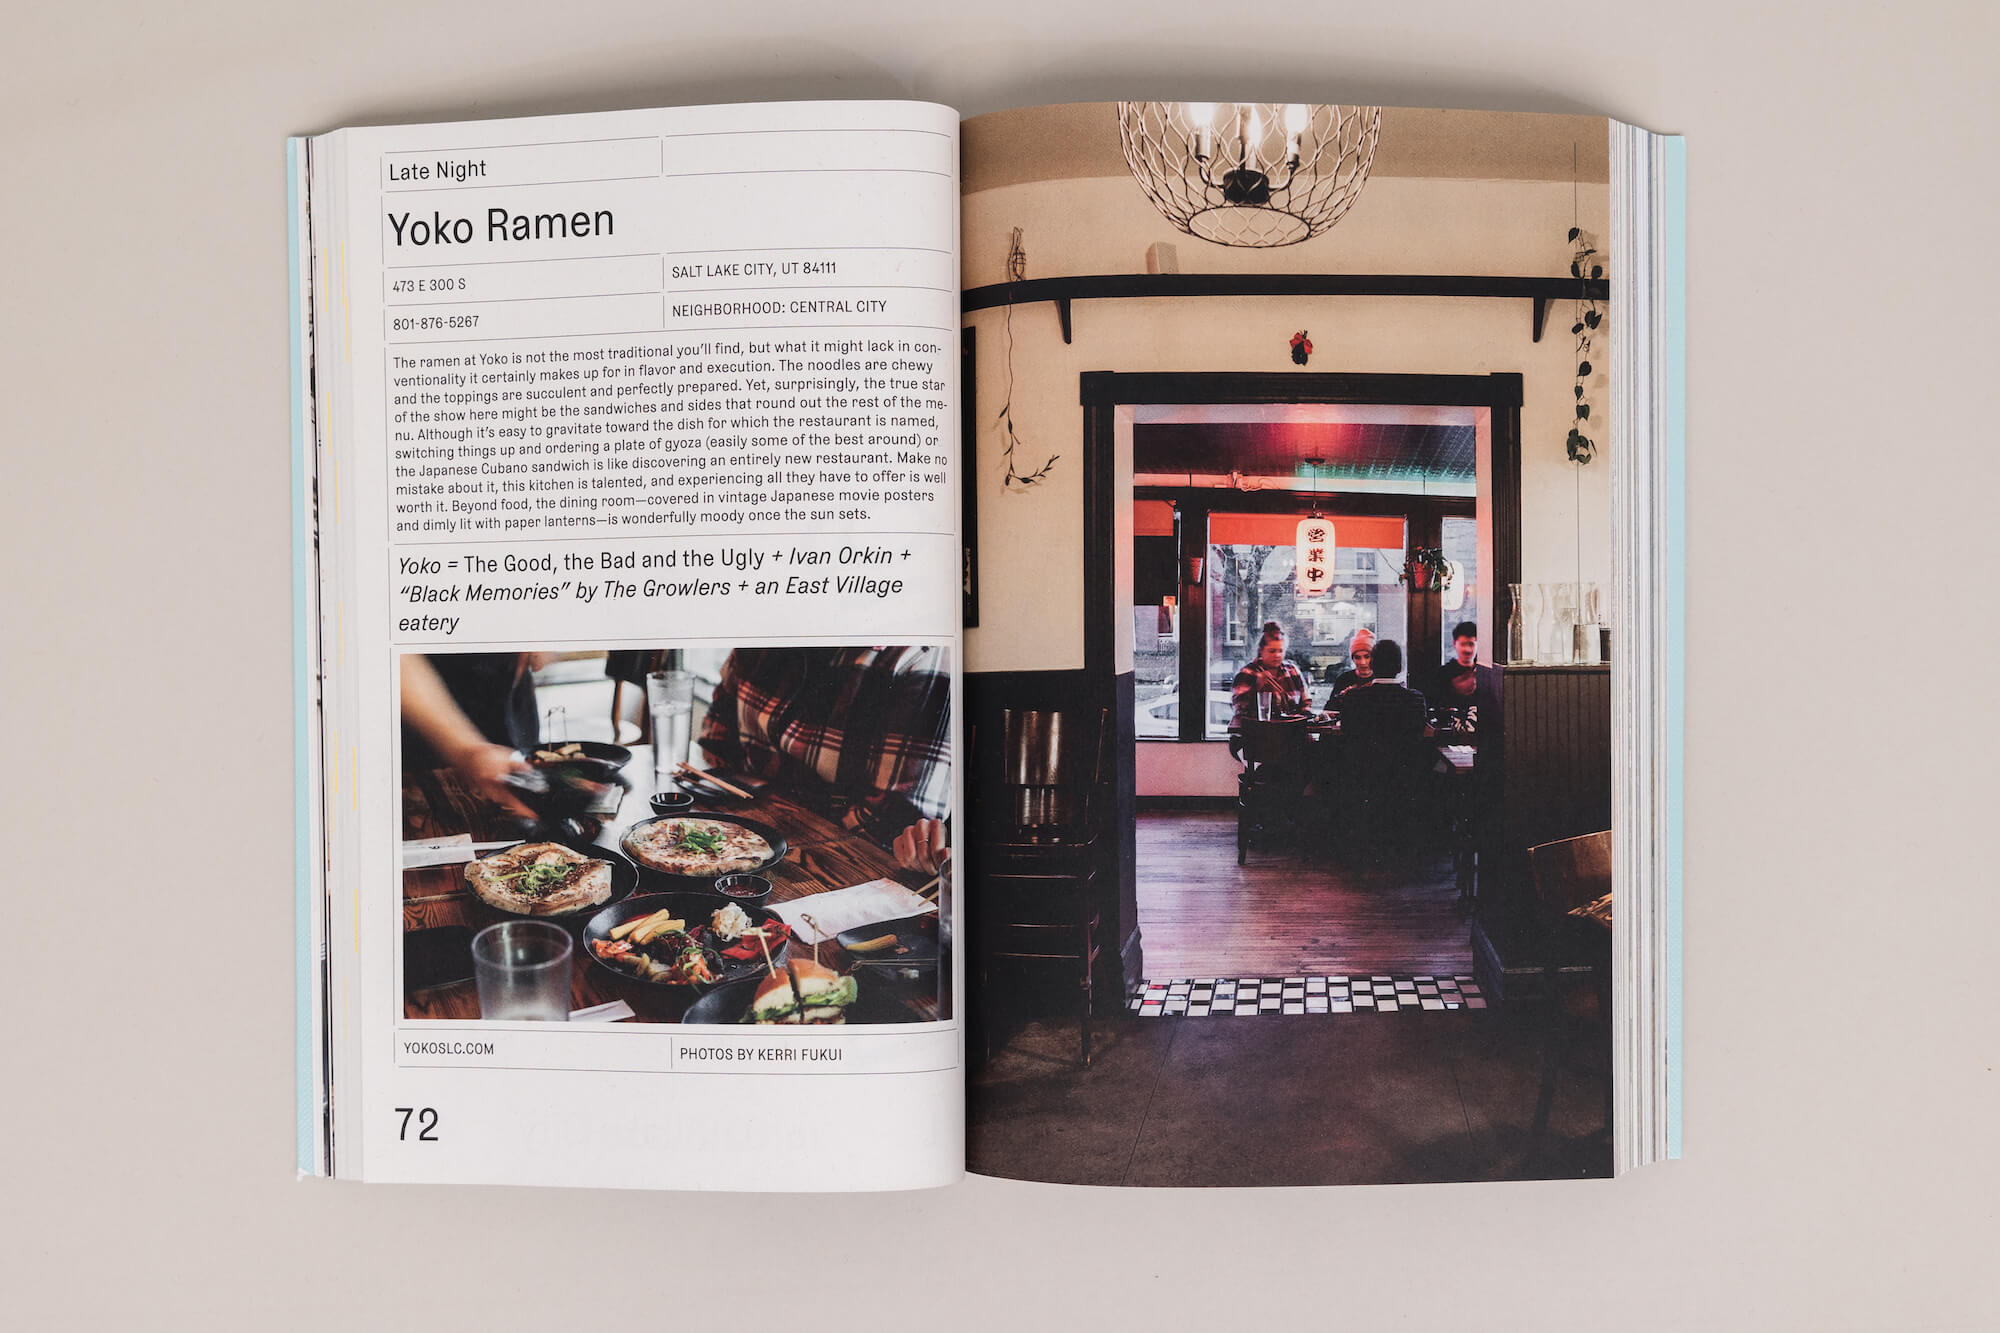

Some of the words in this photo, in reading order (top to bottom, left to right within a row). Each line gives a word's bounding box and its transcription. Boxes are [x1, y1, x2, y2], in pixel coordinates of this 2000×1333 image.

[390, 163, 430, 181] Late
[437, 159, 486, 183] Night
[387, 211, 473, 247] Yoko
[488, 208, 613, 242] Ramen
[672, 265, 703, 279] SALT
[707, 264, 740, 277] LAKE
[744, 262, 777, 278] CITY,
[782, 262, 799, 275] UT
[803, 261, 836, 274] 84111
[392, 280, 415, 292] 473
[419, 279, 426, 292] E
[429, 278, 454, 291] 300
[458, 277, 466, 290] S
[672, 301, 785, 317] NEIGHBORHOOD:
[790, 300, 853, 314] CENTRAL
[856, 300, 887, 313] CITY
[393, 315, 479, 331] 801-876-5267
[393, 356, 416, 368] The
[420, 357, 460, 368] ramen
[464, 354, 476, 366] at
[479, 353, 508, 366] Yoko
[512, 352, 522, 364] is
[526, 351, 546, 363] not
[549, 350, 569, 363] the
[573, 348, 605, 361] most
[608, 344, 673, 360] traditional
[676, 343, 711, 359] you’ll
[715, 342, 744, 357] find,
[749, 341, 770, 354] but
[774, 340, 807, 353] what
[811, 340, 820, 352] it
[824, 339, 863, 355] might
[868, 339, 894, 352] lack
[898, 342, 910, 352] in
[914, 343, 942, 353] con-
[393, 373, 466, 388] ventionality
[470, 372, 478, 384] it
[481, 370, 536, 385] certainly
[540, 368, 580, 381] makes
[583, 369, 599, 382] up
[602, 366, 621, 378] for
[624, 365, 635, 377] in
[638, 364, 676, 376] flavor
[679, 362, 703, 375] and
[707, 360, 775, 374] execution.
[778, 359, 803, 372] The
[808, 358, 861, 371] noodles
[865, 361, 887, 371] are
[891, 358, 933, 375] chewy
[394, 392, 417, 405] and
[420, 392, 441, 404] the
[444, 390, 498, 406] toppings
[502, 391, 522, 401] are
[526, 386, 587, 400] succulent
[590, 384, 613, 397] and
[617, 381, 674, 399] perfectly
[677, 379, 742, 396] prepared.
[745, 378, 770, 393] Yet,
[774, 377, 859, 393] surprisingly,
[864, 377, 886, 389] the
[889, 377, 918, 390] true
[922, 378, 945, 391] star
[395, 432, 414, 441] nu.
[417, 427, 473, 442] Although
[477, 426, 495, 438] it’s
[498, 428, 527, 440] easy
[530, 425, 542, 436] to
[546, 422, 602, 439] gravitate
[605, 419, 649, 433] toward
[653, 419, 674, 431] the
[677, 417, 704, 430] dish
[708, 417, 727, 429] for
[730, 415, 769, 428] which
[773, 415, 795, 428] the
[799, 414, 871, 427] restaurant
[875, 414, 887, 426] is
[891, 415, 939, 431] named,
[395, 446, 454, 461] switching
[458, 445, 496, 460] things
[500, 446, 515, 458] up
[519, 442, 541, 455] and
[545, 441, 599, 455] ordering
[603, 442, 610, 452] a
[614, 439, 645, 454] plate
[649, 437, 663, 450] of
[665, 439, 701, 452] gyoza
[706, 435, 748, 451] (easily
[751, 436, 788, 447] some
[792, 433, 806, 446] of
[808, 433, 830, 446] the
[835, 433, 864, 445] best
[868, 433, 921, 448] around)
[925, 436, 939, 446] or
[396, 501, 432, 513] worth
[436, 500, 448, 512] it.
[452, 498, 497, 515] Beyond
[500, 497, 532, 512] food,
[536, 497, 556, 510] the
[559, 496, 597, 511] dining
[703, 491, 714, 504] in
[718, 491, 767, 506] vintage
[770, 489, 835, 505] Japanese
[839, 488, 880, 501] movie
[884, 489, 934, 504] posters
[396, 519, 419, 532] and
[423, 518, 456, 533] dimly
[460, 518, 472, 530] lit
[475, 517, 501, 529] with
[505, 518, 541, 531] paper
[621, 510, 697, 526] wonderfully
[700, 509, 745, 525] moody
[748, 511, 781, 521] once
[784, 508, 806, 521] the
[810, 510, 834, 520] sun
[838, 508, 871, 520] sets.
[400, 557, 441, 575] Yoko
[463, 555, 498, 573] The
[504, 553, 558, 575] Good,
[563, 552, 594, 571] the
[601, 551, 635, 569] Bad
[642, 549, 676, 568] and
[682, 549, 714, 567] the
[721, 547, 765, 571] Ugly
[772, 550, 783, 562] +
[789, 547, 831, 565] Ivan
[839, 546, 892, 565] Orkin
[900, 549, 912, 560] +
[400, 584, 461, 603] “Black
[465, 581, 571, 602] Memories”
[575, 581, 599, 604] by
[604, 580, 637, 600] The
[643, 578, 731, 597] Growlers
[738, 580, 749, 591] +
[755, 581, 779, 595] an
[785, 576, 830, 594] East
[837, 575, 903, 598] Village
[399, 614, 460, 635] eatery
[404, 1042, 494, 1055] YOKOSLC.COM
[680, 1047, 733, 1061] PHOTOS
[737, 1048, 754, 1061] BY
[758, 1048, 797, 1061] KERRI
[801, 1048, 842, 1061] FUKUI
[394, 1107, 439, 1141] 72
